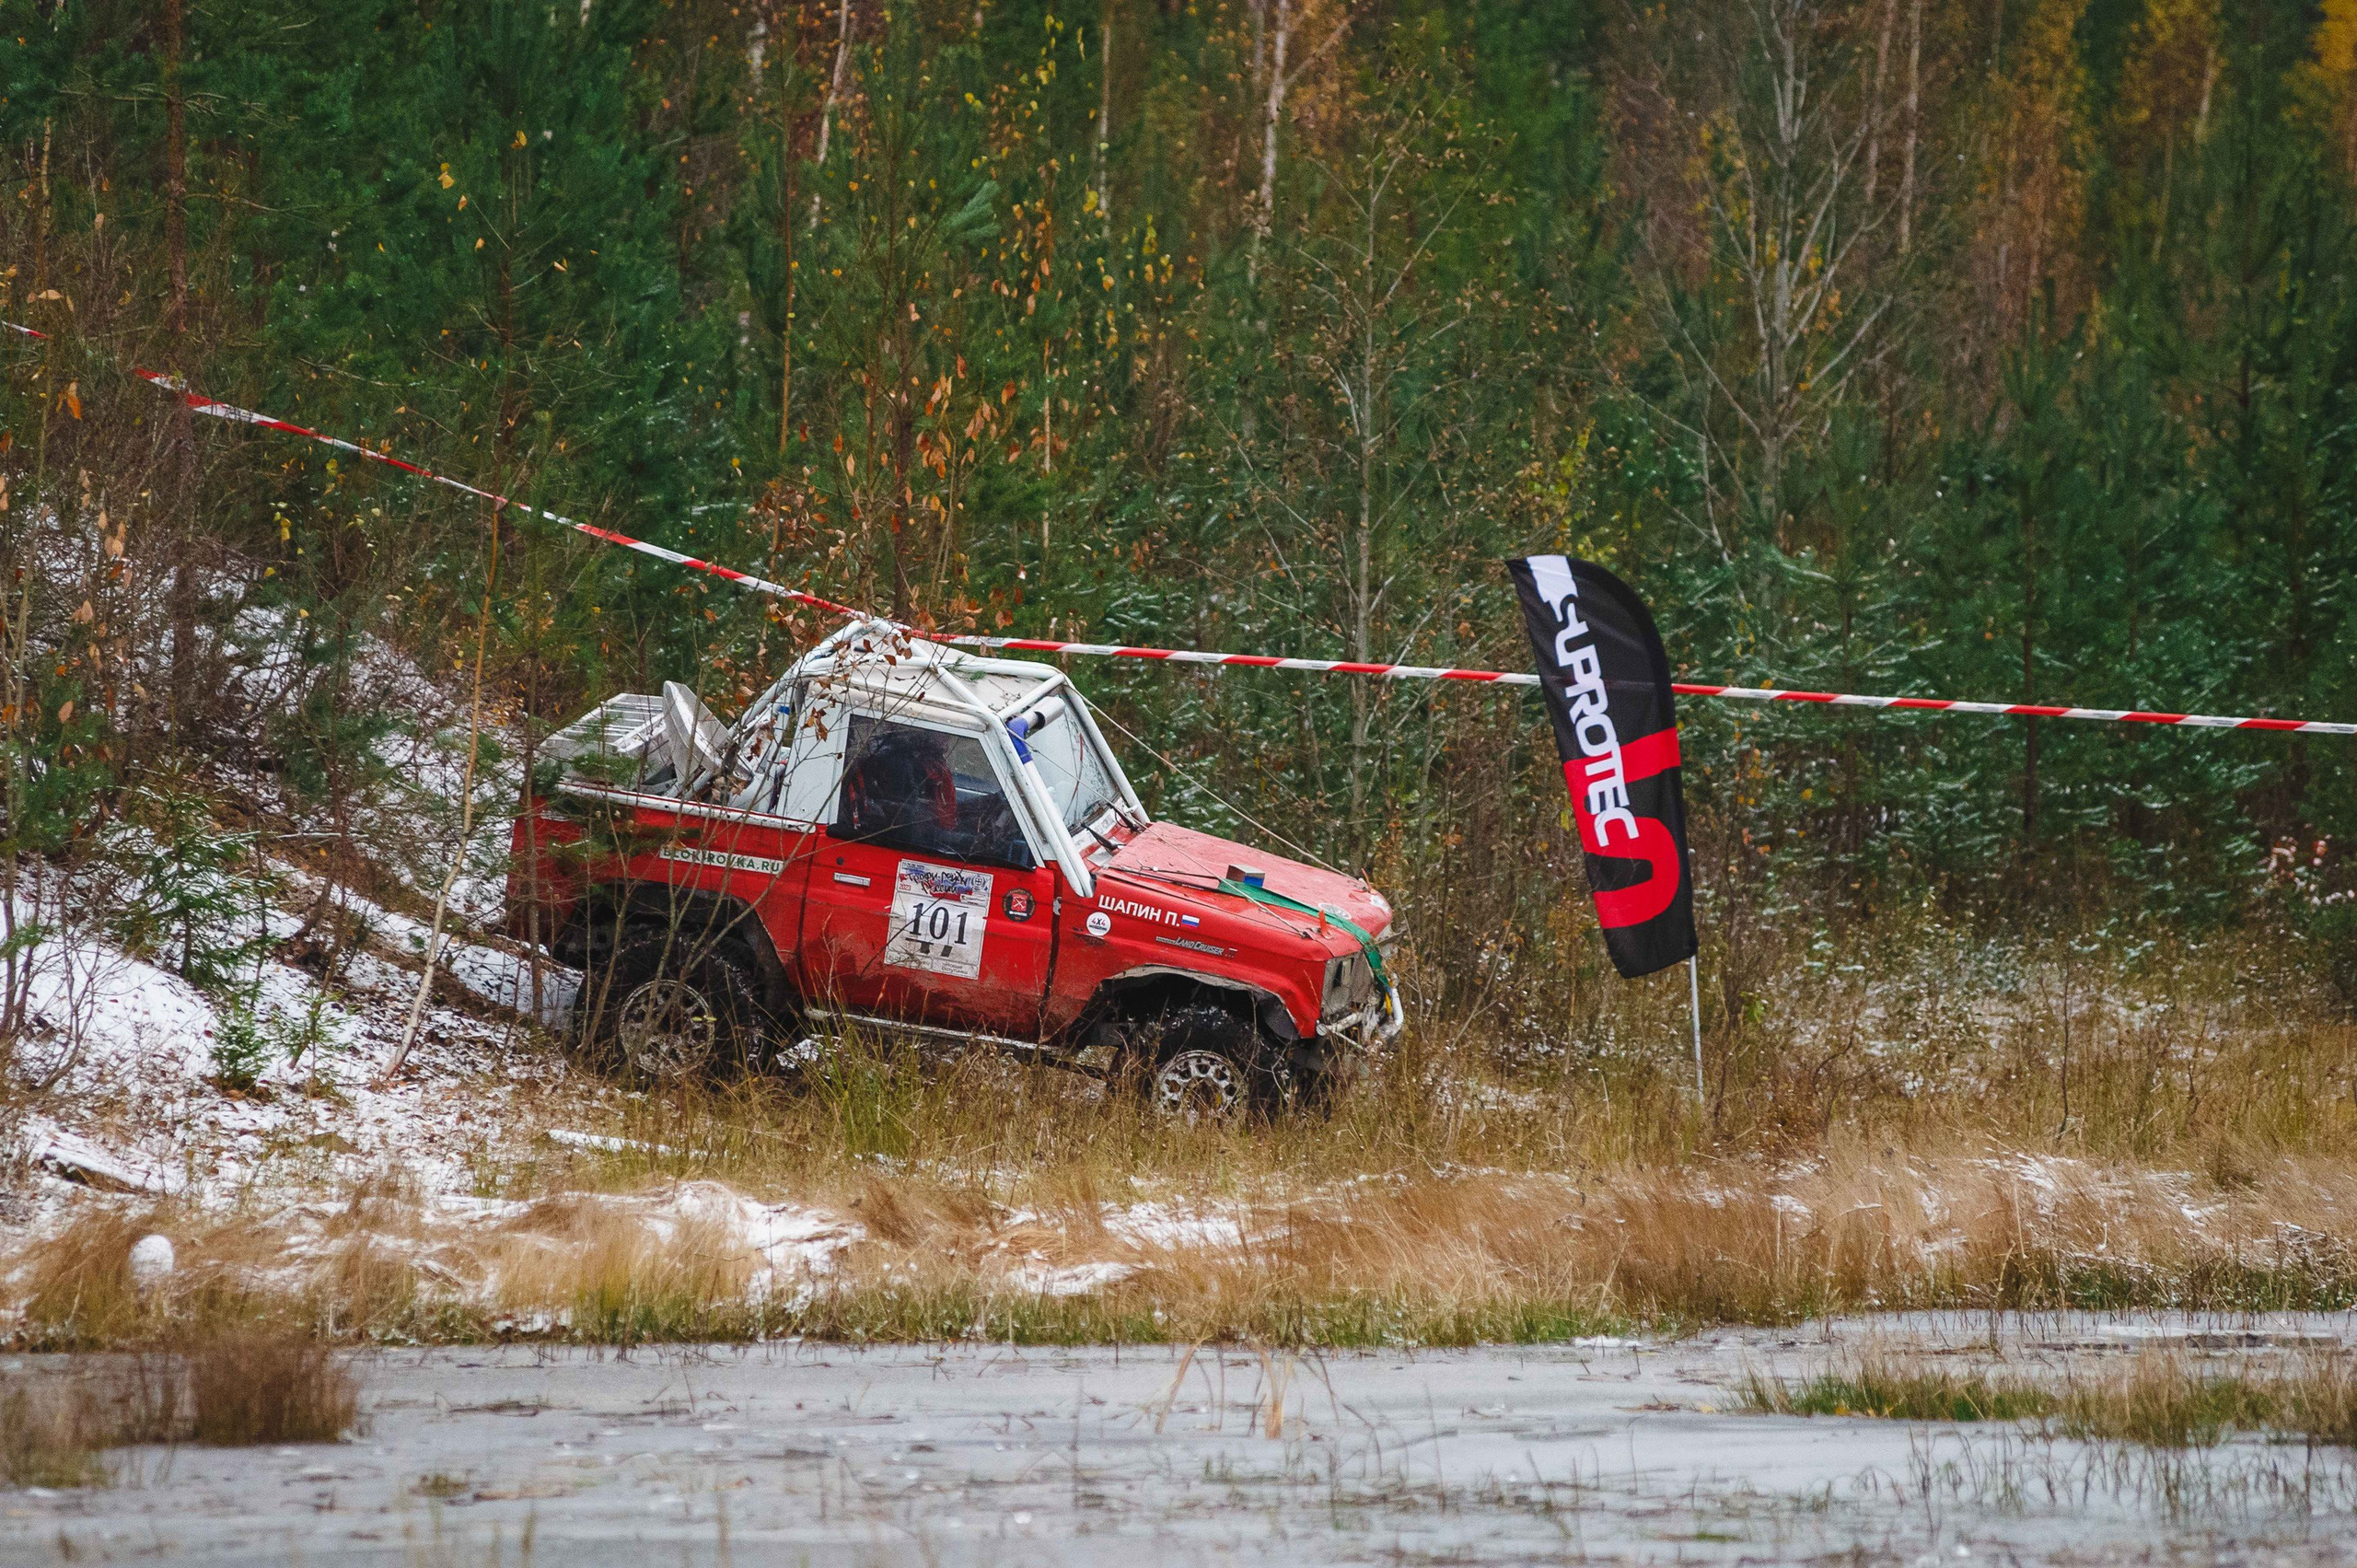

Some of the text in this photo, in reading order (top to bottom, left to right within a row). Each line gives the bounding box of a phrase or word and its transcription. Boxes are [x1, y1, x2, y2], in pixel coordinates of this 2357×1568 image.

[909, 902, 969, 945] 101
[1098, 894, 1180, 927] ШАПИН П.
